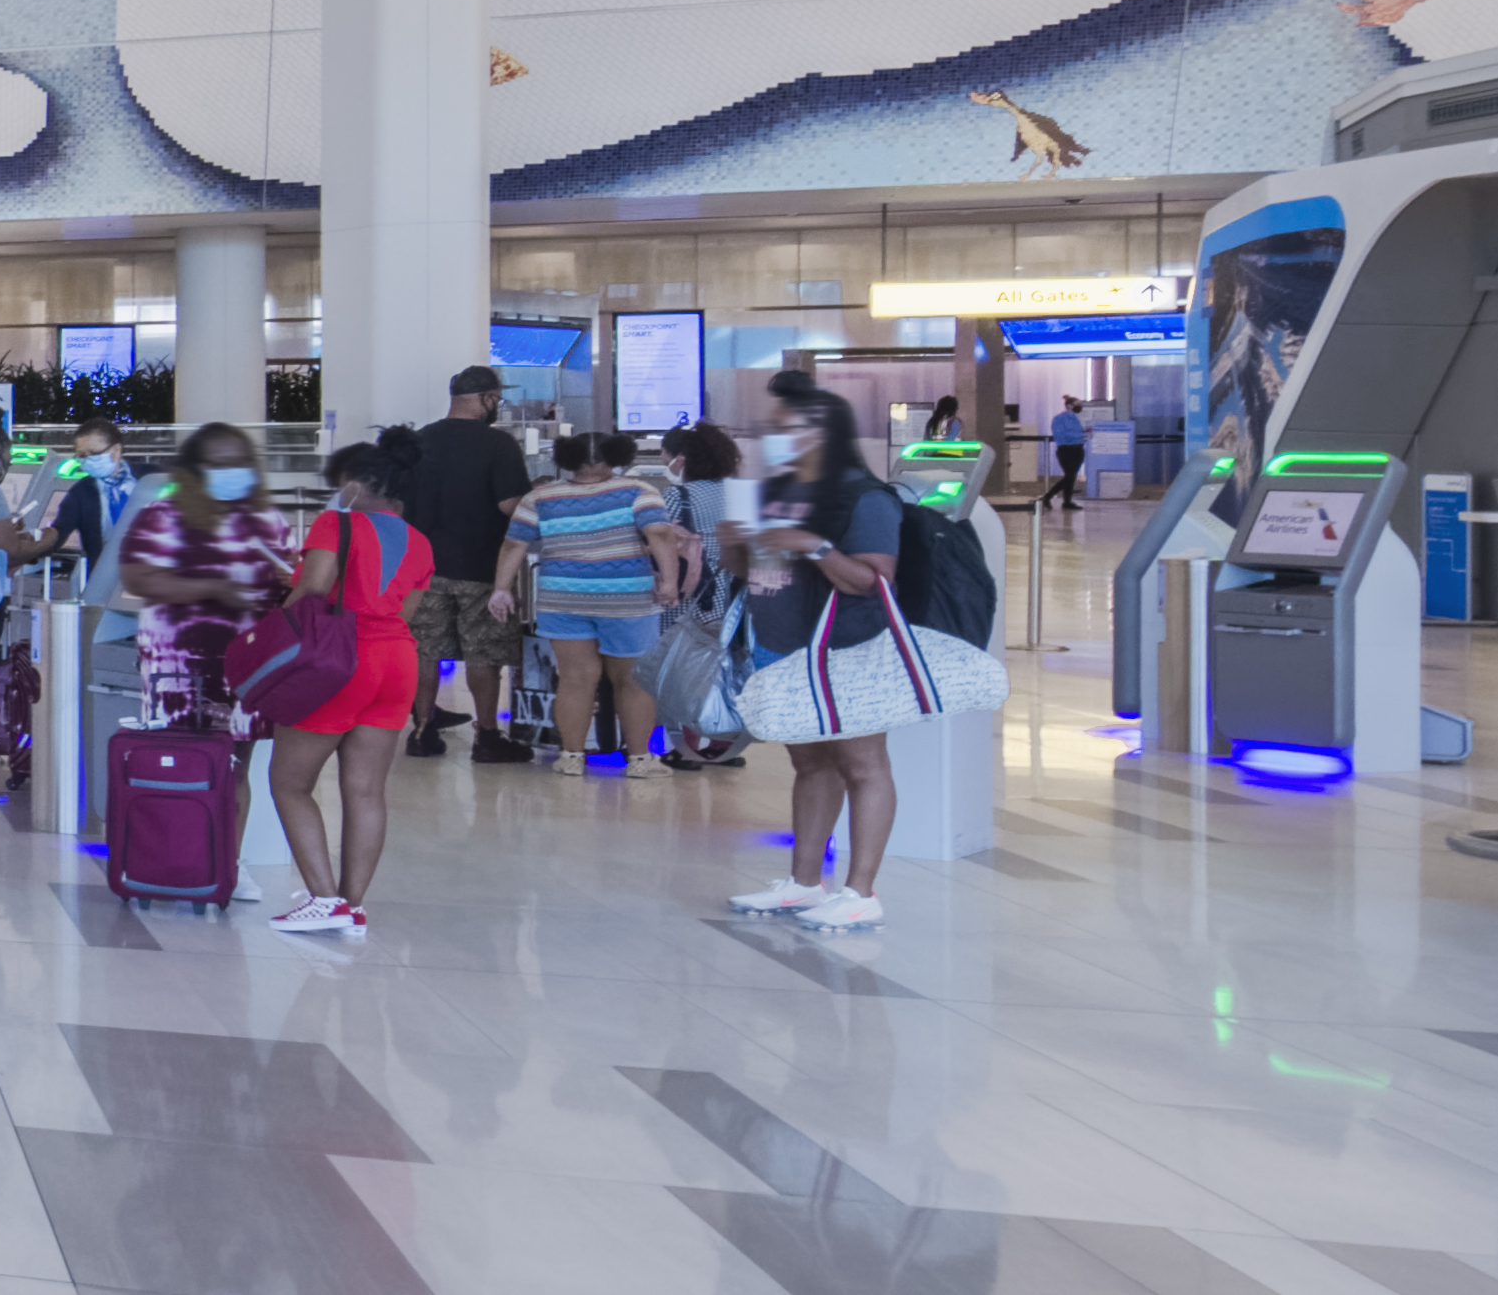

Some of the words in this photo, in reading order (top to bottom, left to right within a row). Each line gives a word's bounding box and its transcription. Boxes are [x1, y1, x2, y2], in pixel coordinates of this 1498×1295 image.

[996, 291, 1022, 303] All
[1031, 290, 1089, 302] Gates
[1260, 513, 1313, 524] American
[1265, 524, 1308, 535] Airlines
[514, 690, 556, 728] NY
